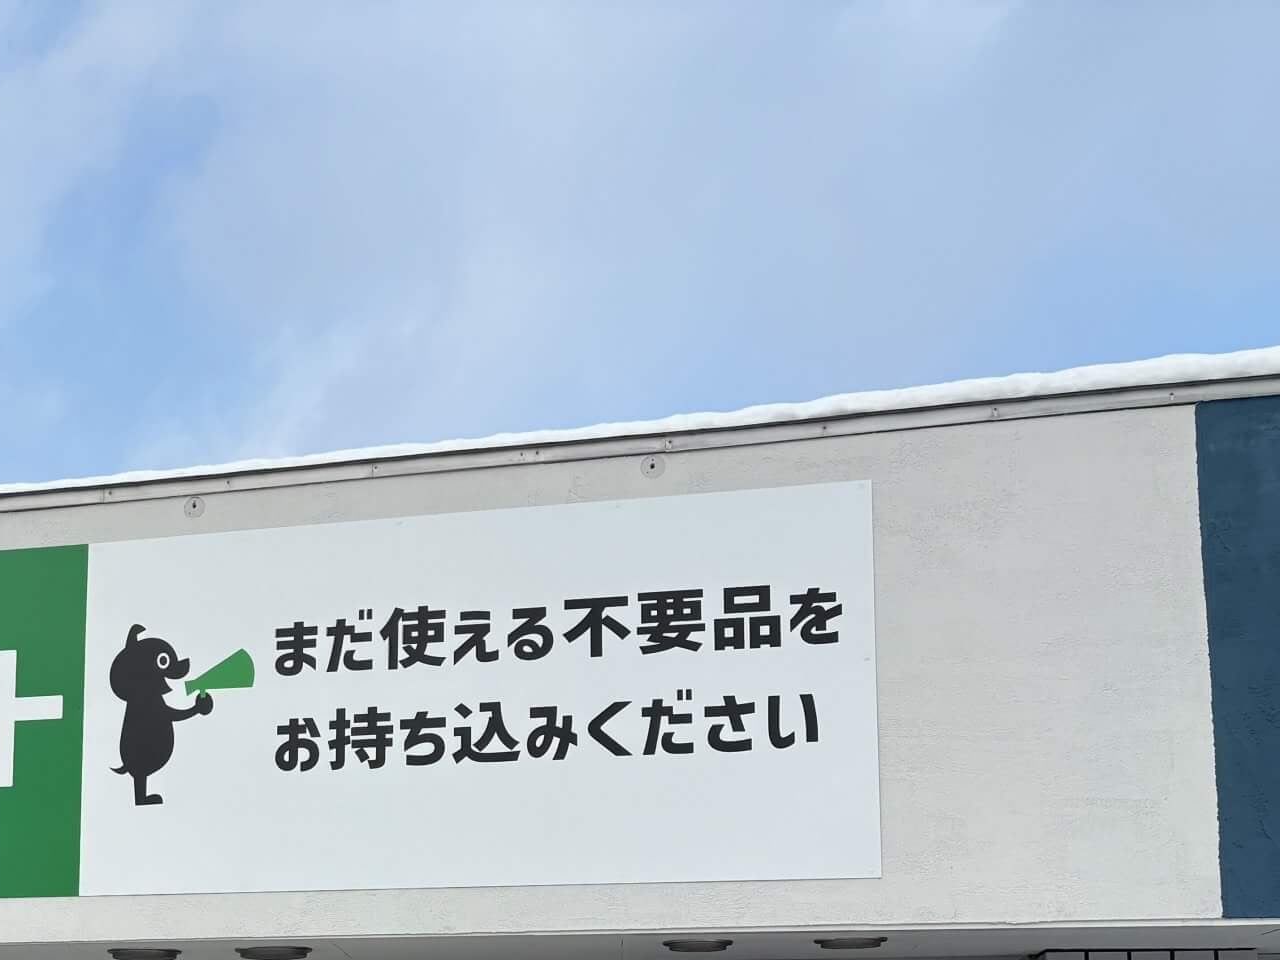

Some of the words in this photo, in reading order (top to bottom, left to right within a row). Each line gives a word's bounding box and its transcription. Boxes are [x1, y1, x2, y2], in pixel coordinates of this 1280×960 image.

[275, 585, 843, 676] まだ使える不要品を
[275, 690, 819, 771] お持ち込みください
